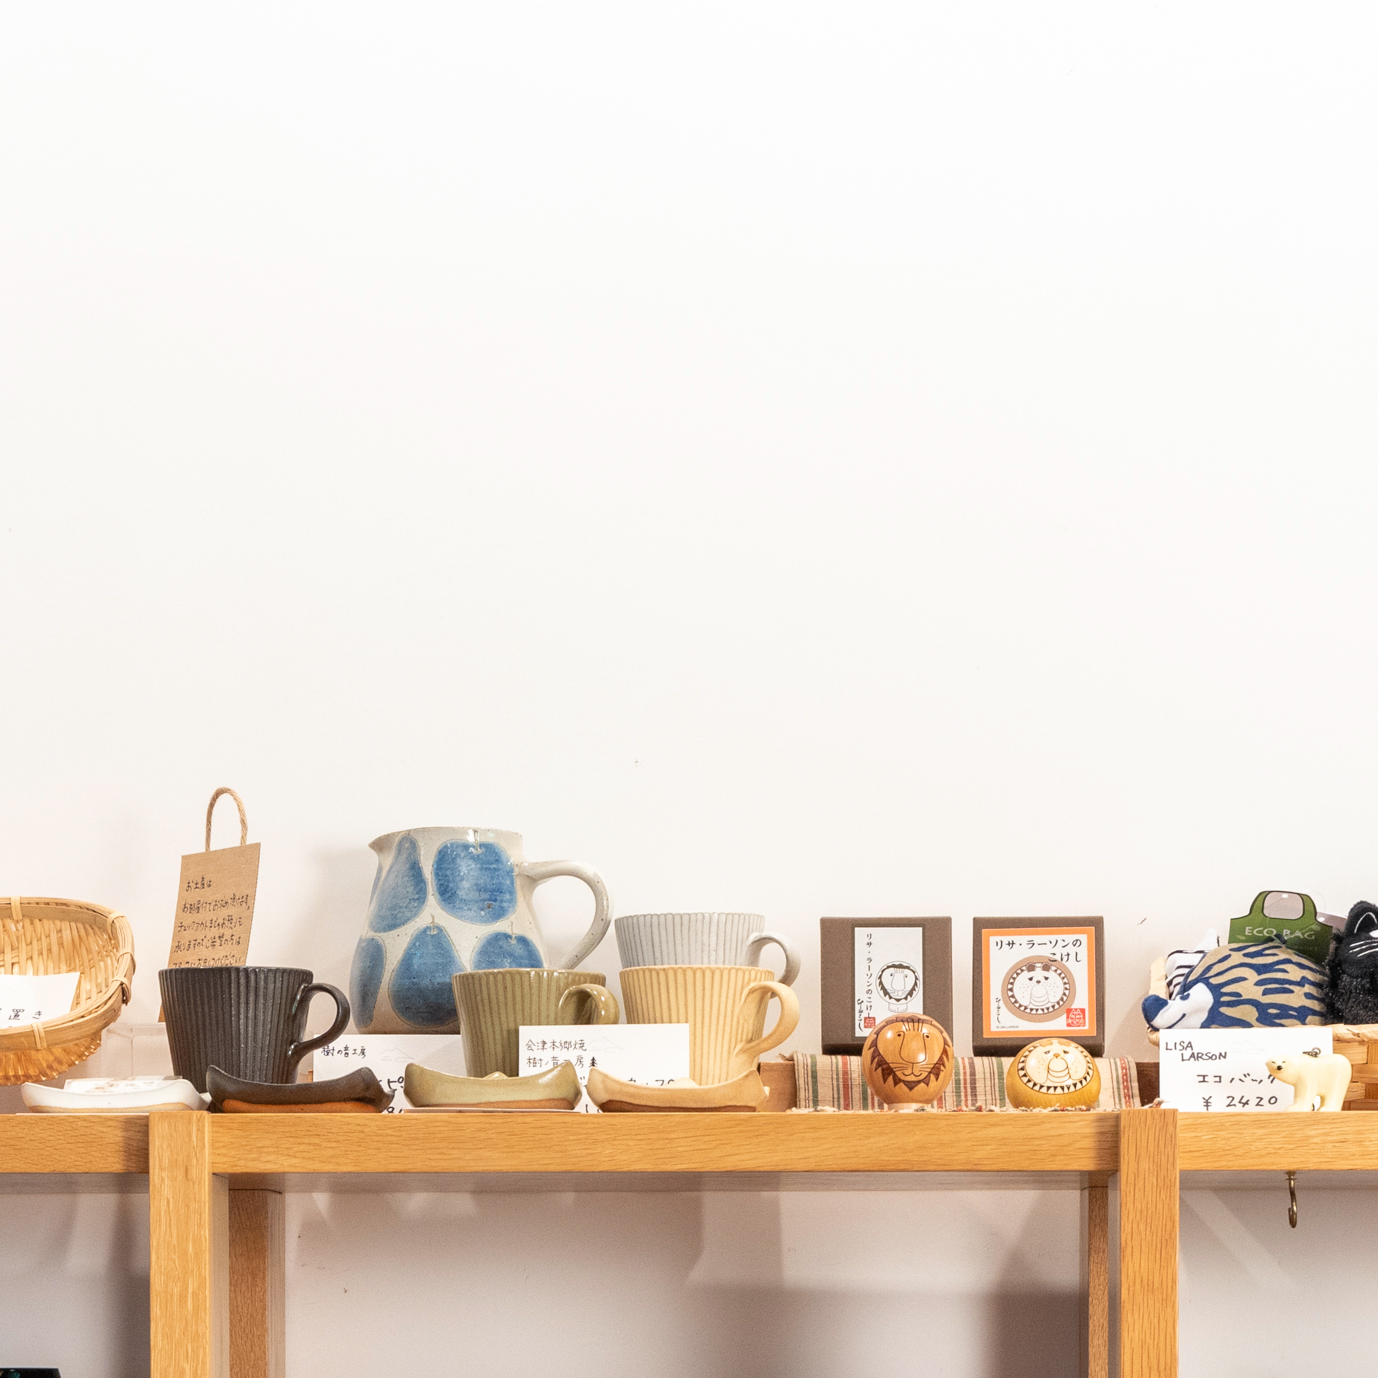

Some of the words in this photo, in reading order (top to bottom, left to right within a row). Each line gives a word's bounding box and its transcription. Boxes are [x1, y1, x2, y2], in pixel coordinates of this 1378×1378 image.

[1244, 926, 1277, 937] ECO
[1282, 929, 1315, 940] BAG
[995, 938, 1082, 950] リサ・ラーソンの
[1048, 951, 1082, 963] こけし
[525, 1038, 587, 1053] 会津本郷焼
[1166, 1041, 1193, 1051] LISA
[321, 1046, 366, 1059] 樹の音工房
[1181, 1051, 1227, 1062] LARSON
